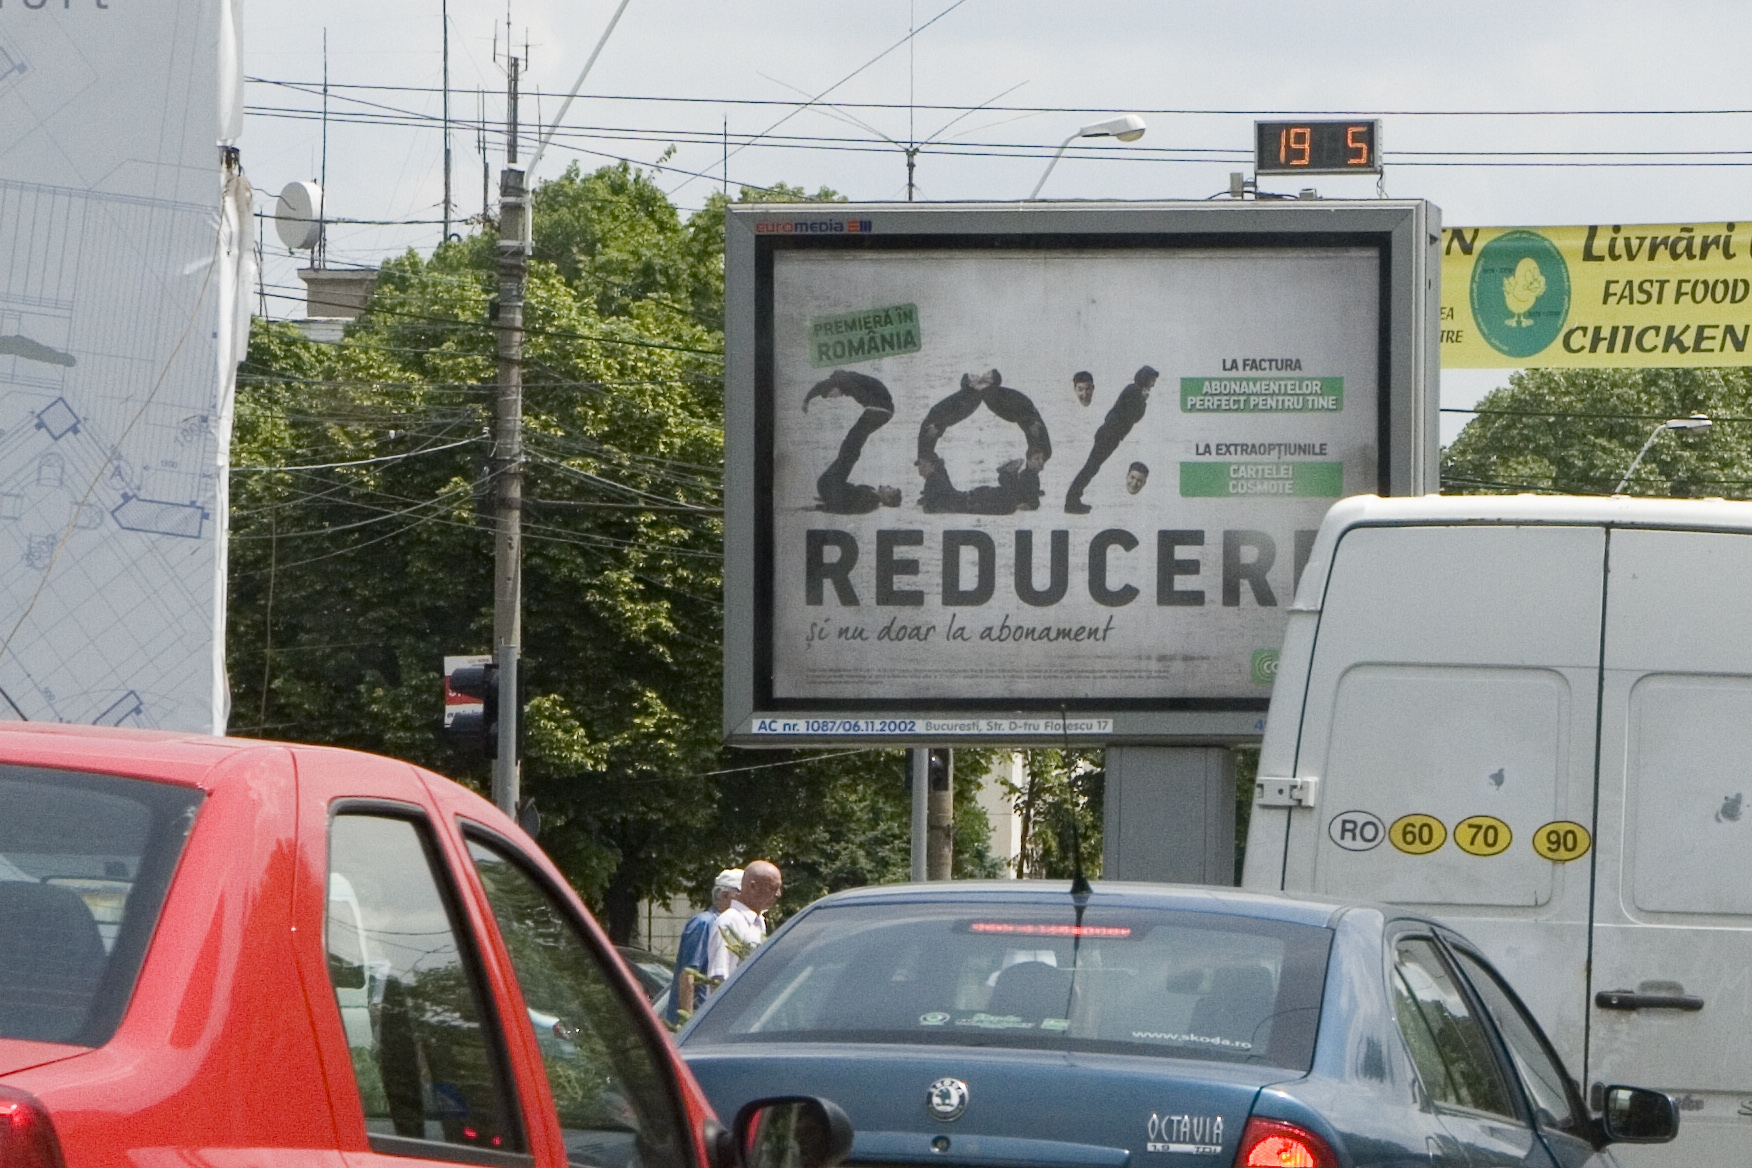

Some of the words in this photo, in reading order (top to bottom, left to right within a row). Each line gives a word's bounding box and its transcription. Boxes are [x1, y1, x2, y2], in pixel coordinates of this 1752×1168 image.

[1602, 279, 1670, 305] FAST
[1674, 278, 1750, 305] FOOD
[814, 310, 893, 337] PREMIERĂ
[899, 307, 914, 325] ÎN
[818, 330, 918, 362] ROMÂNIA
[1562, 324, 1750, 354] CHICKEN
[1222, 359, 1238, 371] LA
[1243, 359, 1302, 371] FACTURA
[1202, 381, 1321, 395] ABONAMENTELOR
[1187, 396, 1246, 409] PERFECT
[1251, 396, 1302, 409] PENTRU
[1307, 396, 1337, 409] TINE
[1196, 443, 1211, 456] LA
[1229, 465, 1293, 478] CARTELEI
[1229, 481, 1293, 494] COSMOTE
[837, 627, 868, 641] nu
[876, 616, 935, 642] doar
[946, 613, 970, 641] la
[980, 614, 1115, 642] abonament
[758, 721, 778, 732] AC
[783, 721, 799, 732] nr.
[805, 720, 916, 732] 1087/06.11.2002
[986, 721, 1005, 731] Str.
[1097, 721, 1108, 731] 17
[1340, 819, 1379, 843] RO
[1402, 822, 1434, 846] 60
[1467, 823, 1499, 848] 70
[1546, 829, 1578, 852] 90
[1132, 1031, 1252, 1048] www.skoda.ro
[1148, 1113, 1223, 1144] OCTAVIA
